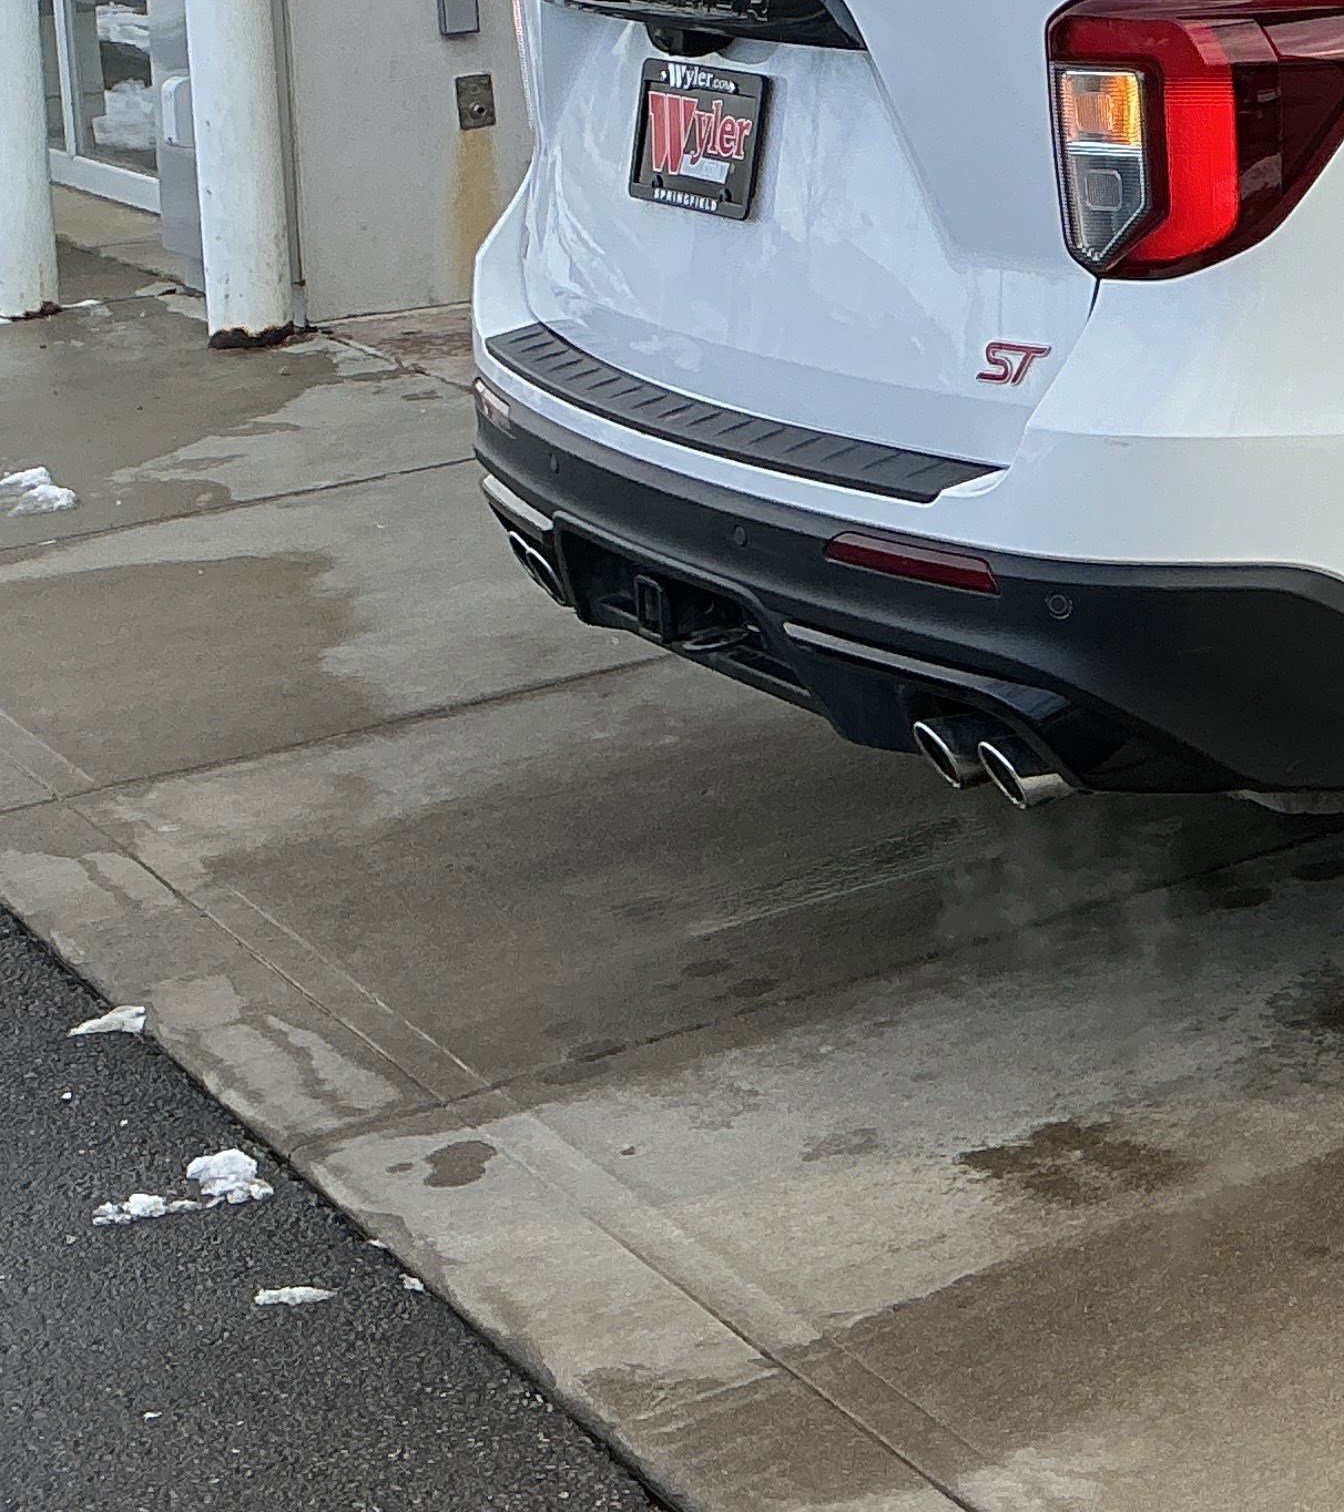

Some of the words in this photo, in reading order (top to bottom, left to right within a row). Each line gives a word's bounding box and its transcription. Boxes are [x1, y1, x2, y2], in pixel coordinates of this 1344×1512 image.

[648, 90, 753, 175] Wyler
[653, 188, 718, 212] SPRINGFIELD
[976, 340, 1052, 386] ST
